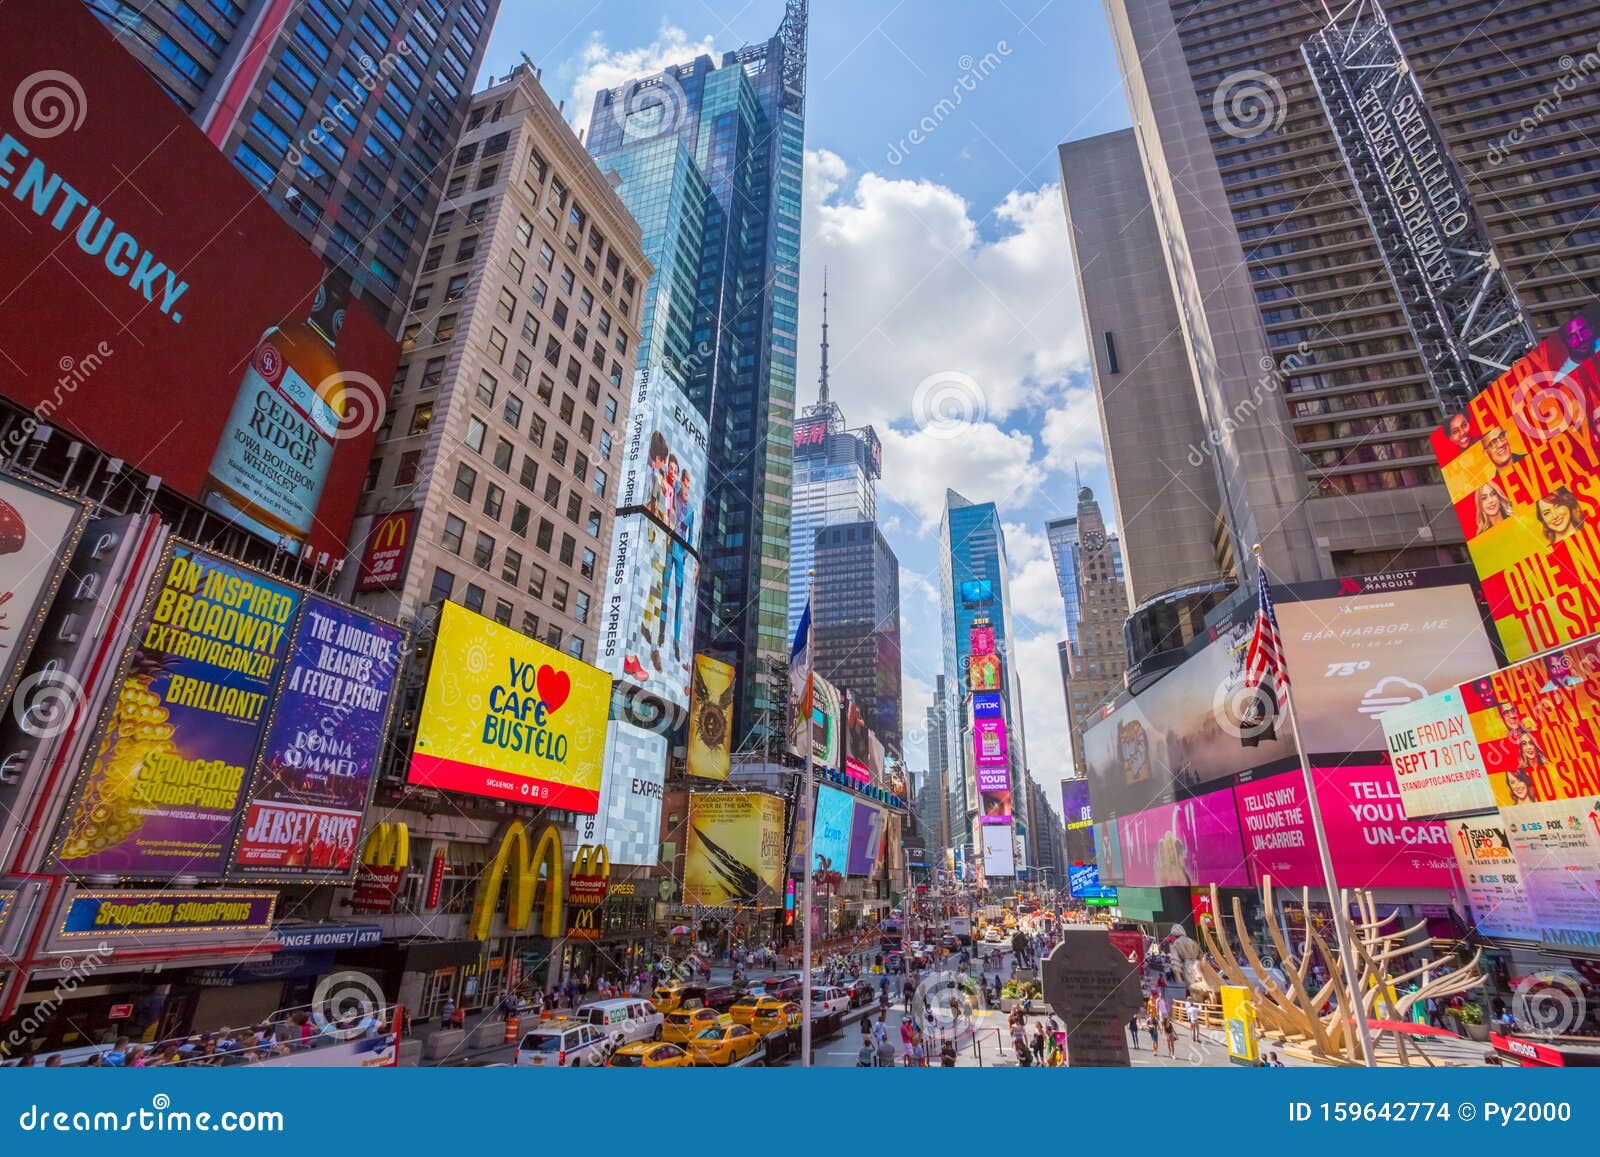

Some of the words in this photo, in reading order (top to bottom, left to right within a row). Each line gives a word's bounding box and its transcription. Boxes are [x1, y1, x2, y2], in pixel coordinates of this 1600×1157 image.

[1356, 86, 1399, 160] EAGLE
[1392, 94, 1468, 237] OUTFITTERS
[1384, 153, 1455, 283] AMERICAN
[248, 407, 317, 470] RIDGE
[256, 389, 320, 452] CEDAR
[629, 413, 644, 462] EXPRESS
[234, 427, 261, 455] IOWA
[262, 444, 315, 491] BOURBON
[243, 450, 298, 494] WHISKEY
[372, 559, 395, 573] 24
[614, 531, 629, 585] EXPRESS
[1364, 571, 1418, 583] MARRIOTT
[1365, 579, 1414, 590] MARQUIS
[202, 569, 293, 624] INSPIRED
[154, 587, 285, 655] BROADWAY
[605, 595, 622, 657] EXPRESS
[1302, 628, 1334, 641] BAR
[1423, 619, 1449, 630] ME
[1515, 601, 1560, 654] TO
[335, 623, 394, 663] AUDIENCE
[288, 665, 303, 691] A
[301, 669, 344, 703] FEVER
[509, 656, 536, 694] YO
[295, 731, 353, 759] DONNA
[481, 713, 569, 763] BUSTELO
[1389, 729, 1418, 753] LIVE
[1416, 714, 1465, 746] FRIDAY
[1395, 750, 1428, 776] SEPT
[1430, 748, 1439, 769] 7
[1401, 768, 1482, 792] STANDUPTOCANCER.ORG
[1244, 794, 1265, 812] TELL
[1263, 790, 1276, 808] US
[1275, 786, 1296, 806] WHY
[1349, 781, 1401, 799] TELL
[247, 807, 317, 845] JERSEY
[316, 813, 357, 850] BOYS
[1245, 813, 1263, 831] YOU
[1262, 810, 1286, 829] LOVE
[1284, 807, 1305, 826] THE
[1349, 804, 1394, 822] YOU
[1526, 822, 1543, 831] CBS
[1546, 820, 1564, 830] FOX
[1251, 830, 1305, 851] UN-CARRIER
[1470, 828, 1494, 839] STAND
[1472, 839, 1483, 849] UP
[1482, 838, 1493, 848] TO
[1475, 847, 1508, 858] CANCER
[570, 879, 607, 889] McDonald's
[1486, 875, 1499, 883] CBS
[1502, 874, 1518, 884] FOX
[313, 932, 354, 945] MONEY
[358, 931, 381, 943] ATM
